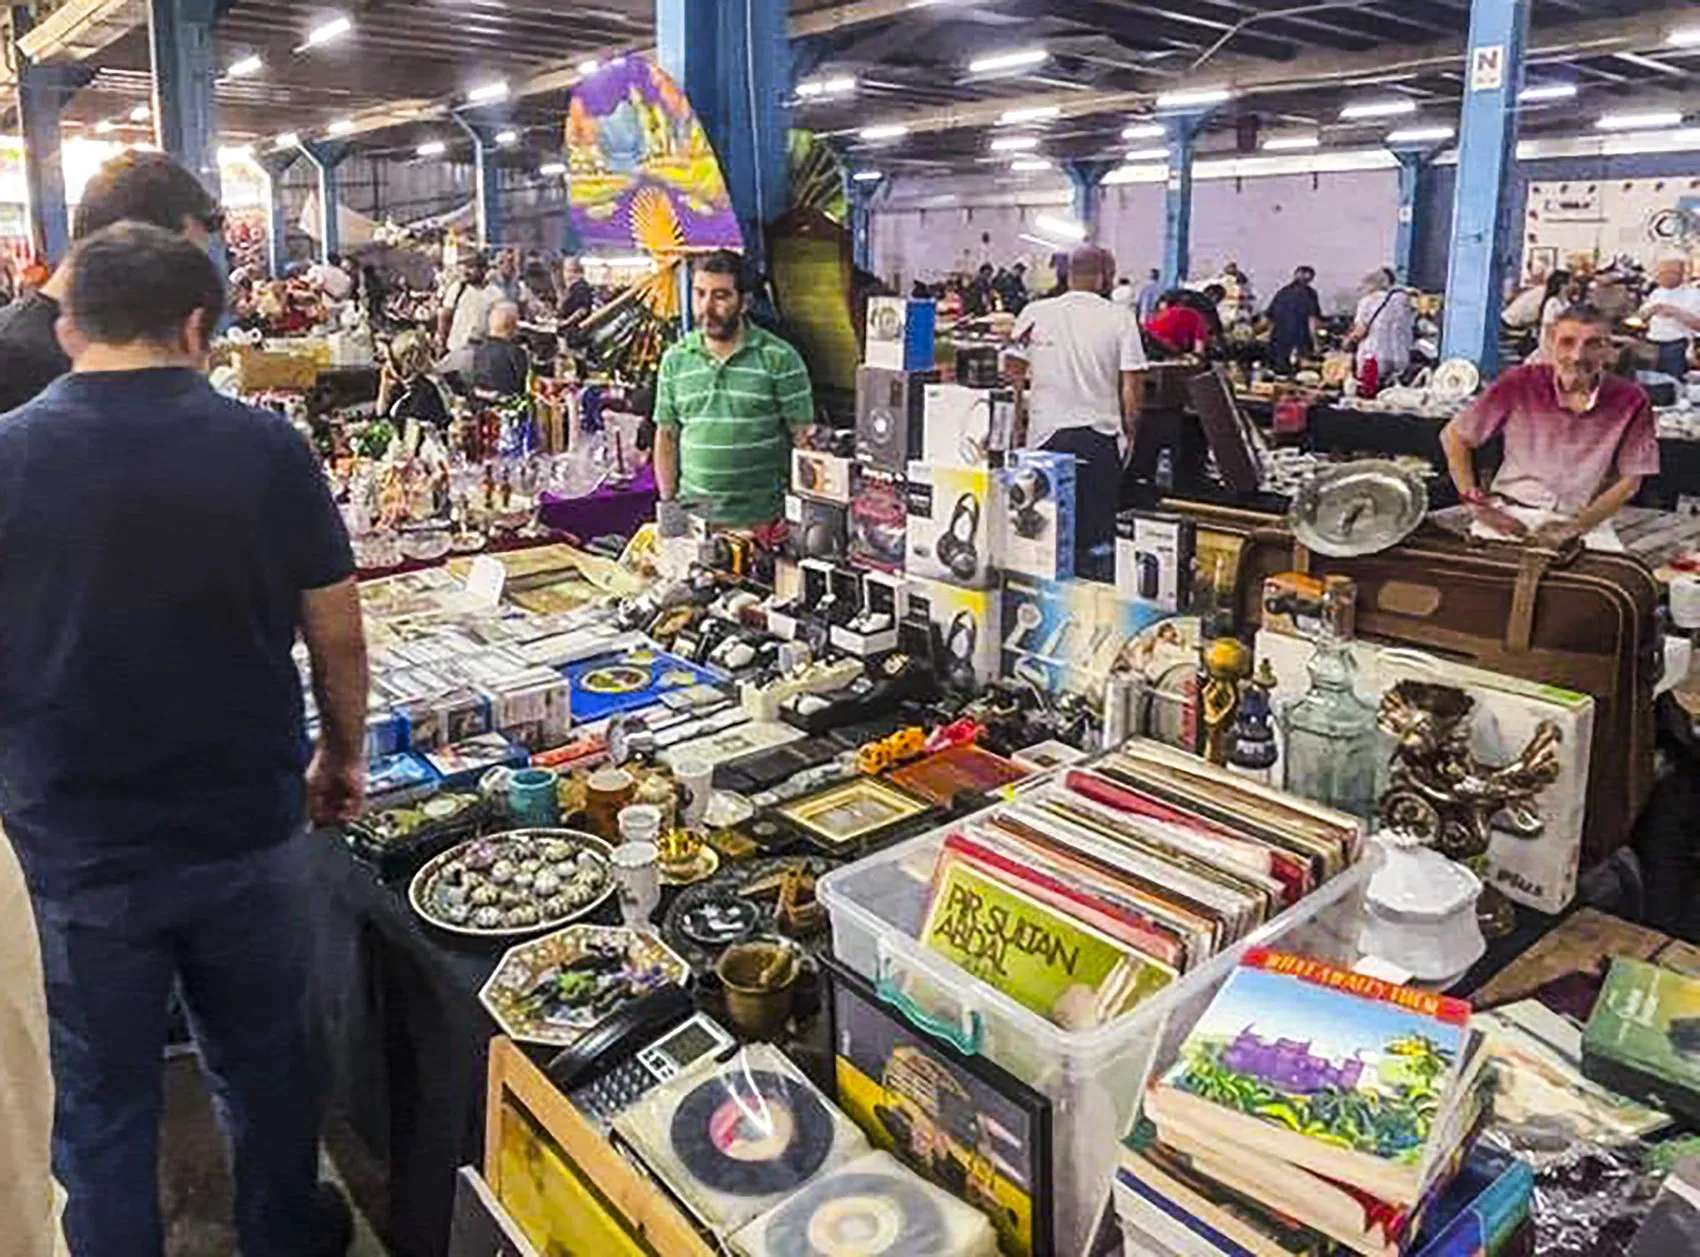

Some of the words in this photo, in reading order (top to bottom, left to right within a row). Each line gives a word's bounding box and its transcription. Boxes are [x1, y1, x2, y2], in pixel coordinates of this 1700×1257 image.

[1478, 50, 1498, 71] N
[933, 913, 1008, 977] ABDAL
[983, 905, 1080, 977] SULTAN
